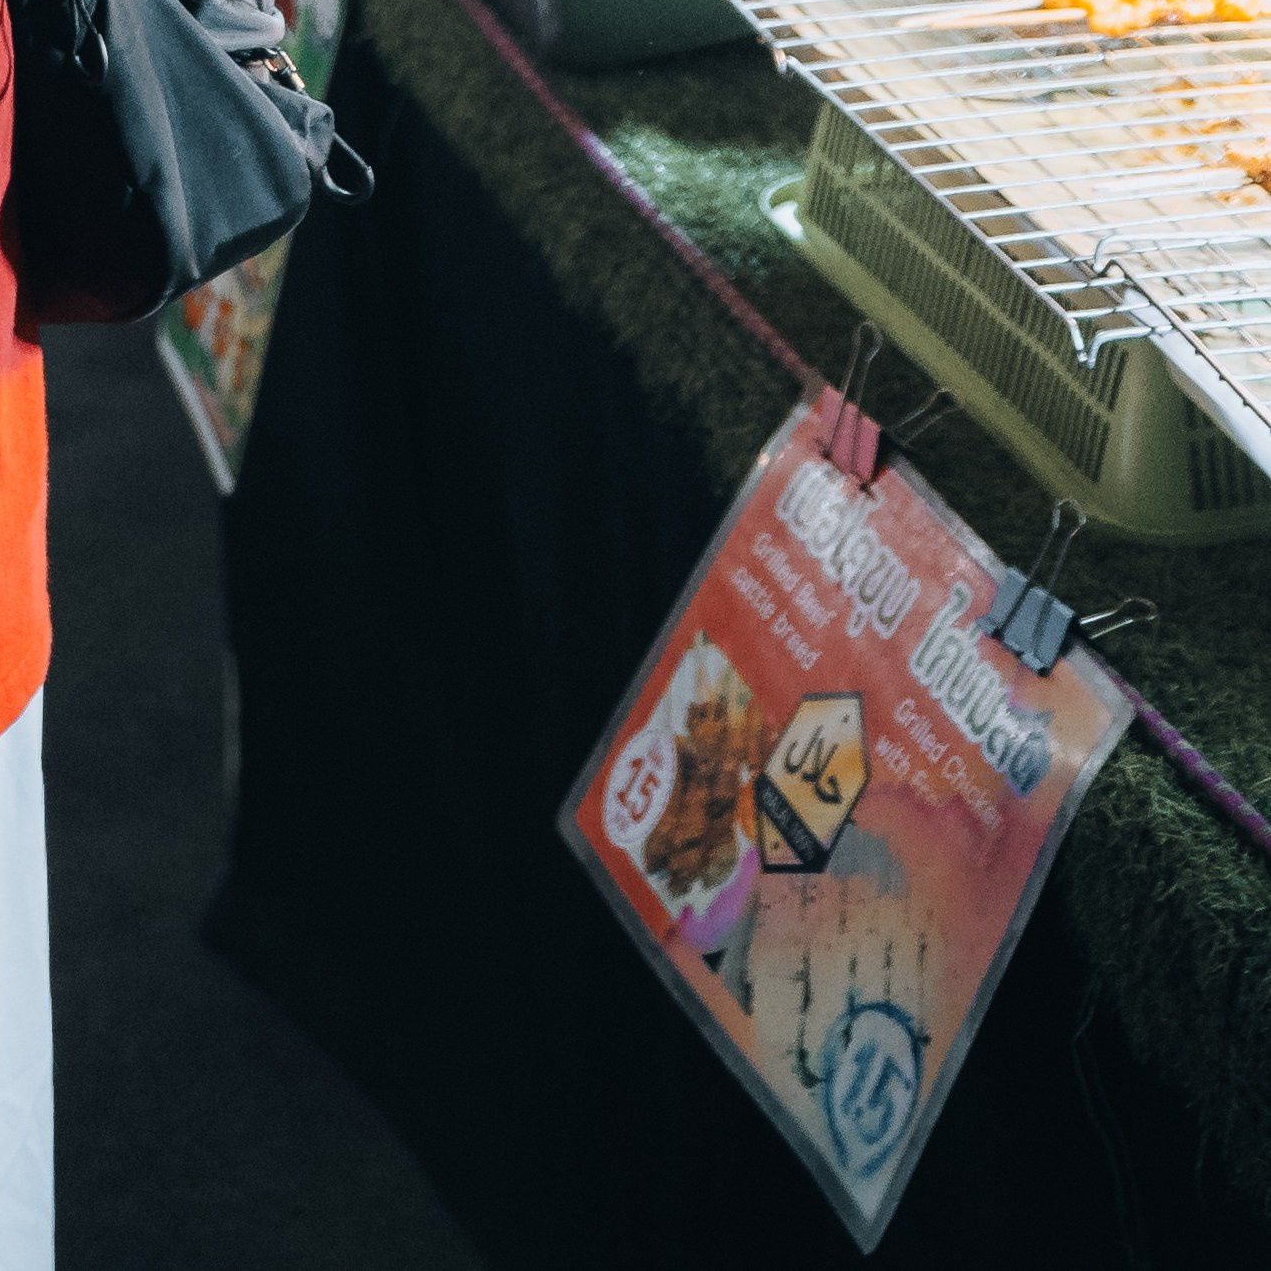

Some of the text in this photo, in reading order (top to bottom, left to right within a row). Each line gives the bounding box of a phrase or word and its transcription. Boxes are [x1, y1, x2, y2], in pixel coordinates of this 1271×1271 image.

[752, 532, 837, 629] Grilled Beef
[771, 613, 822, 672] breed
[875, 735, 911, 779] with
[893, 698, 949, 763] Grilled
[615, 756, 660, 824] 15
[784, 724, 843, 804] حلال
